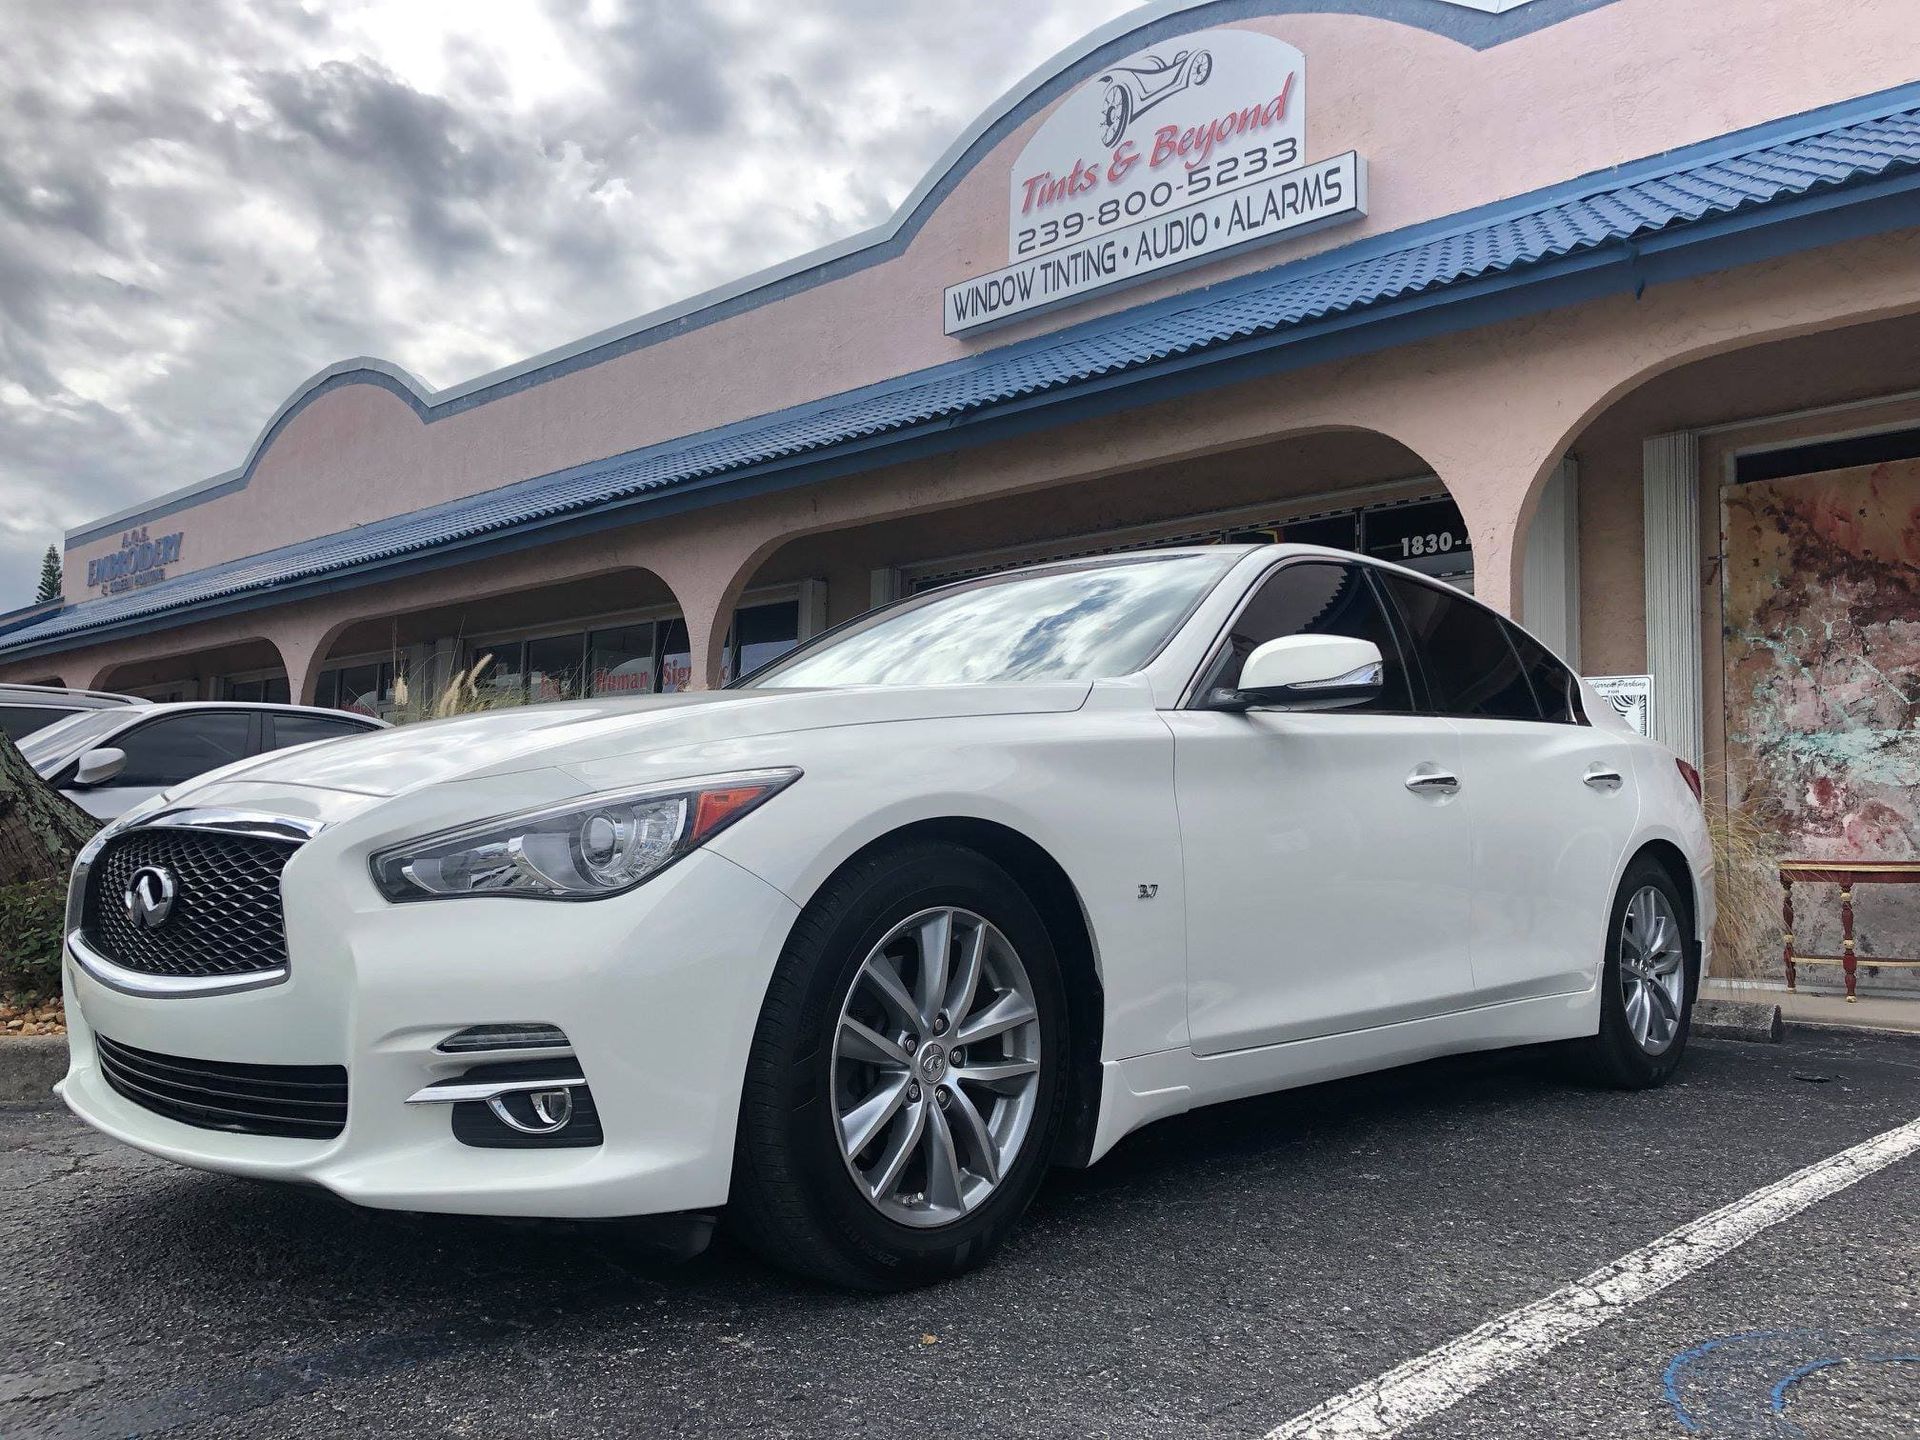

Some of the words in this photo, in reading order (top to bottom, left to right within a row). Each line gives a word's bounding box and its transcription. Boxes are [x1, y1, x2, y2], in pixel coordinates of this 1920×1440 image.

[1017, 137, 1297, 254] 239-800-5233
[1022, 158, 1098, 214] Tints
[1107, 140, 1140, 184] &
[1149, 72, 1295, 168] Beyond
[953, 269, 1035, 321] WINDOW
[1041, 241, 1116, 294] TINTING
[1135, 212, 1208, 266] AUDIO
[1227, 167, 1342, 236] ALARMS
[595, 671, 648, 691] Human
